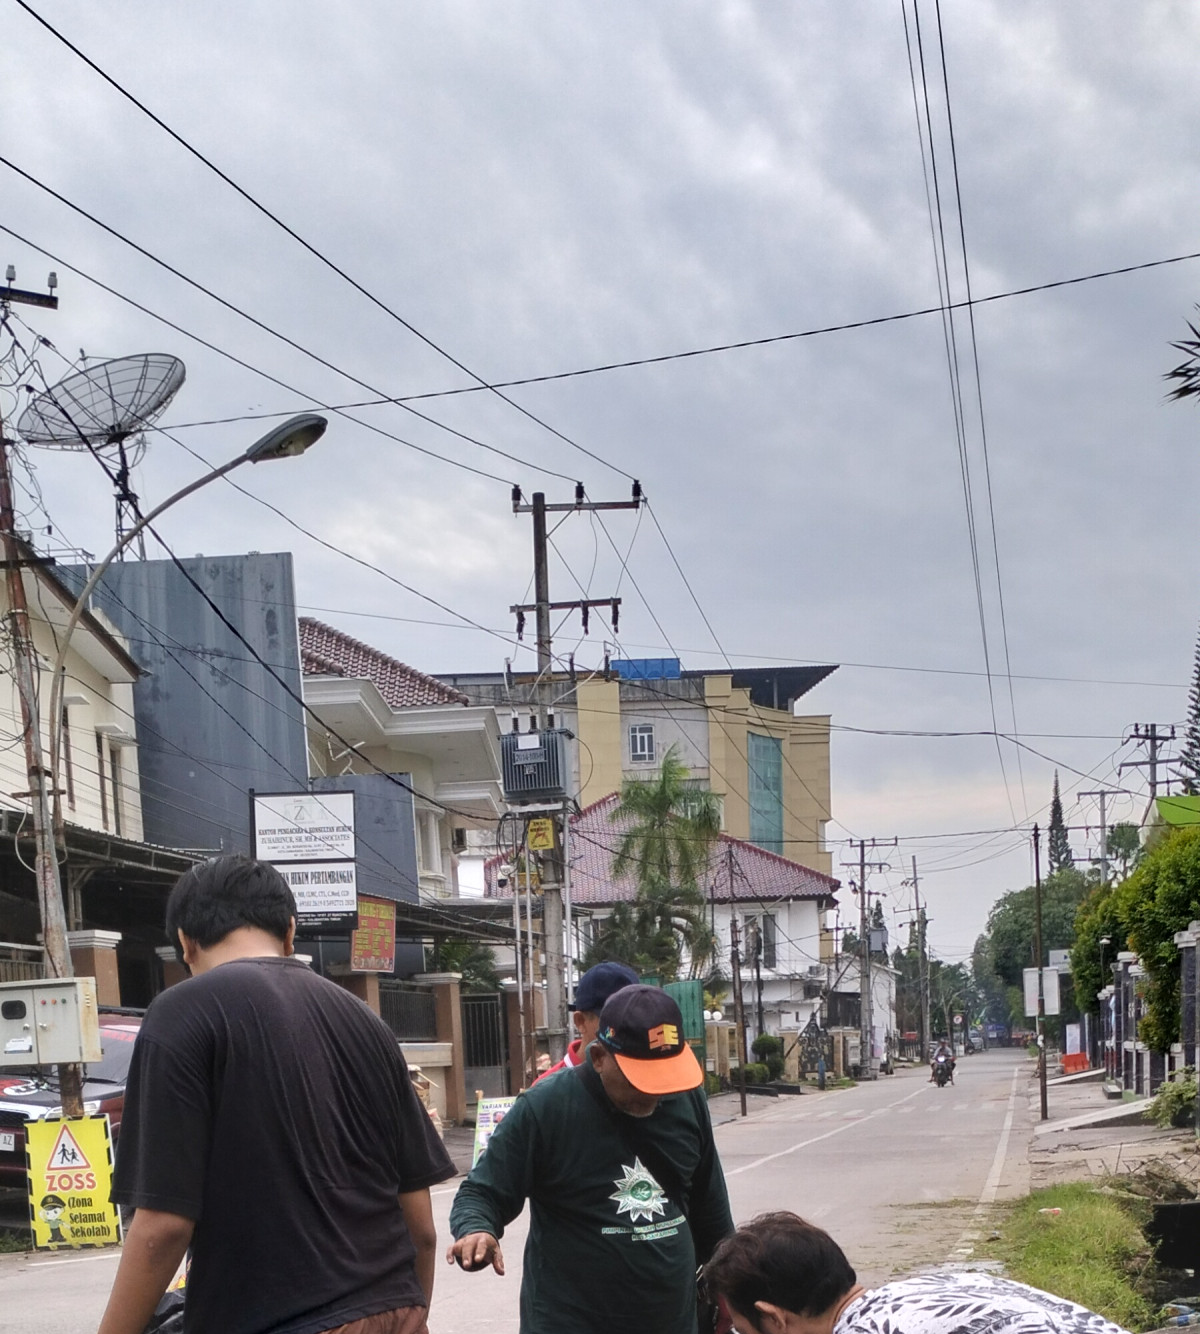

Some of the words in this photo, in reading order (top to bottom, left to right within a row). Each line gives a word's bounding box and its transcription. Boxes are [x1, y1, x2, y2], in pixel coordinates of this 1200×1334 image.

[290, 871, 309, 885] HUKUM
[310, 870, 353, 885] PERTAMBANGAN
[45, 1172, 96, 1192] ZOSS
[67, 1196, 93, 1209] (Zona
[69, 1211, 106, 1224] Selamat
[70, 1224, 111, 1238] Sekolah)
